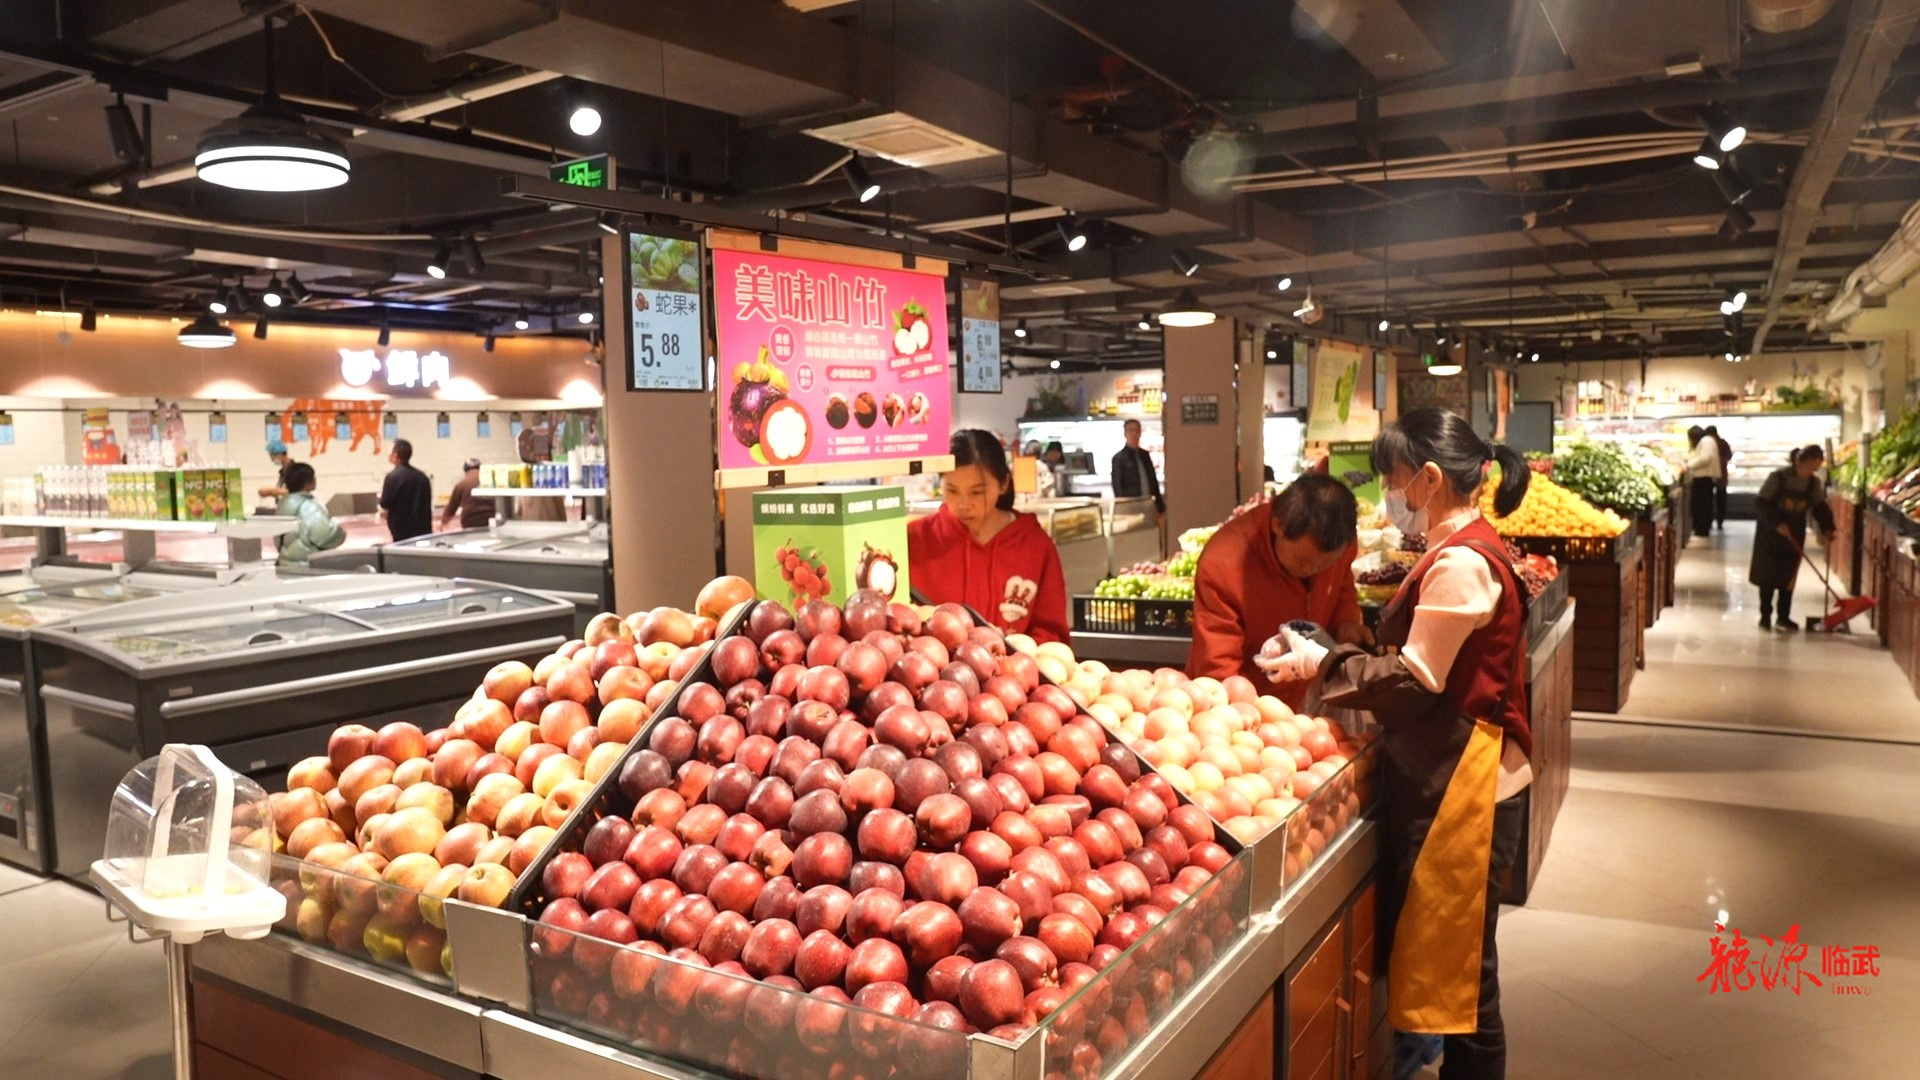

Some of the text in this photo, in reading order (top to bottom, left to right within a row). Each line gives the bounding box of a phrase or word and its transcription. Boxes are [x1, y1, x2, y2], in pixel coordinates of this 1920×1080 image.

[735, 263, 886, 329] 美味山竹
[641, 333, 680, 368] 5.88
